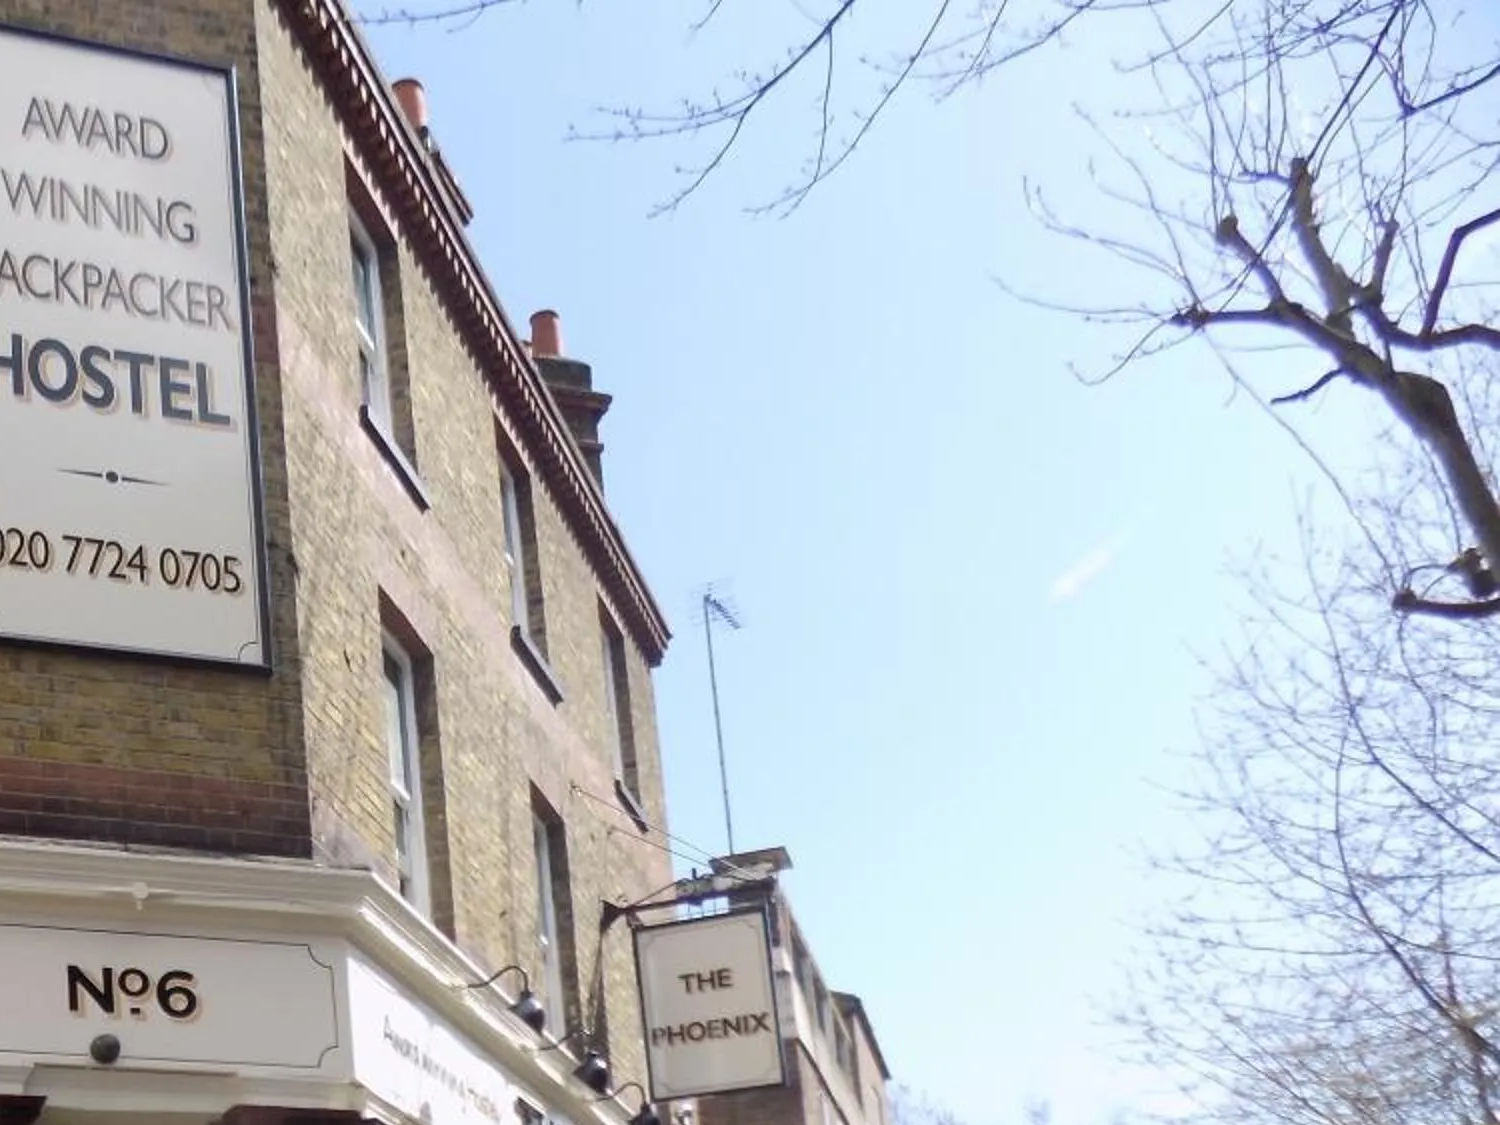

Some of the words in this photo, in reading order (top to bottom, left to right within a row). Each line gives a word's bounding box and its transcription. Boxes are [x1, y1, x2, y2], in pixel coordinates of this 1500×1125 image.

[21, 96, 169, 160] AWARD
[0, 166, 195, 243] WINNING
[62, 535, 148, 582] 7724
[159, 548, 241, 593] 0705
[677, 968, 734, 995] THE
[651, 1012, 772, 1047] PHOENIX
